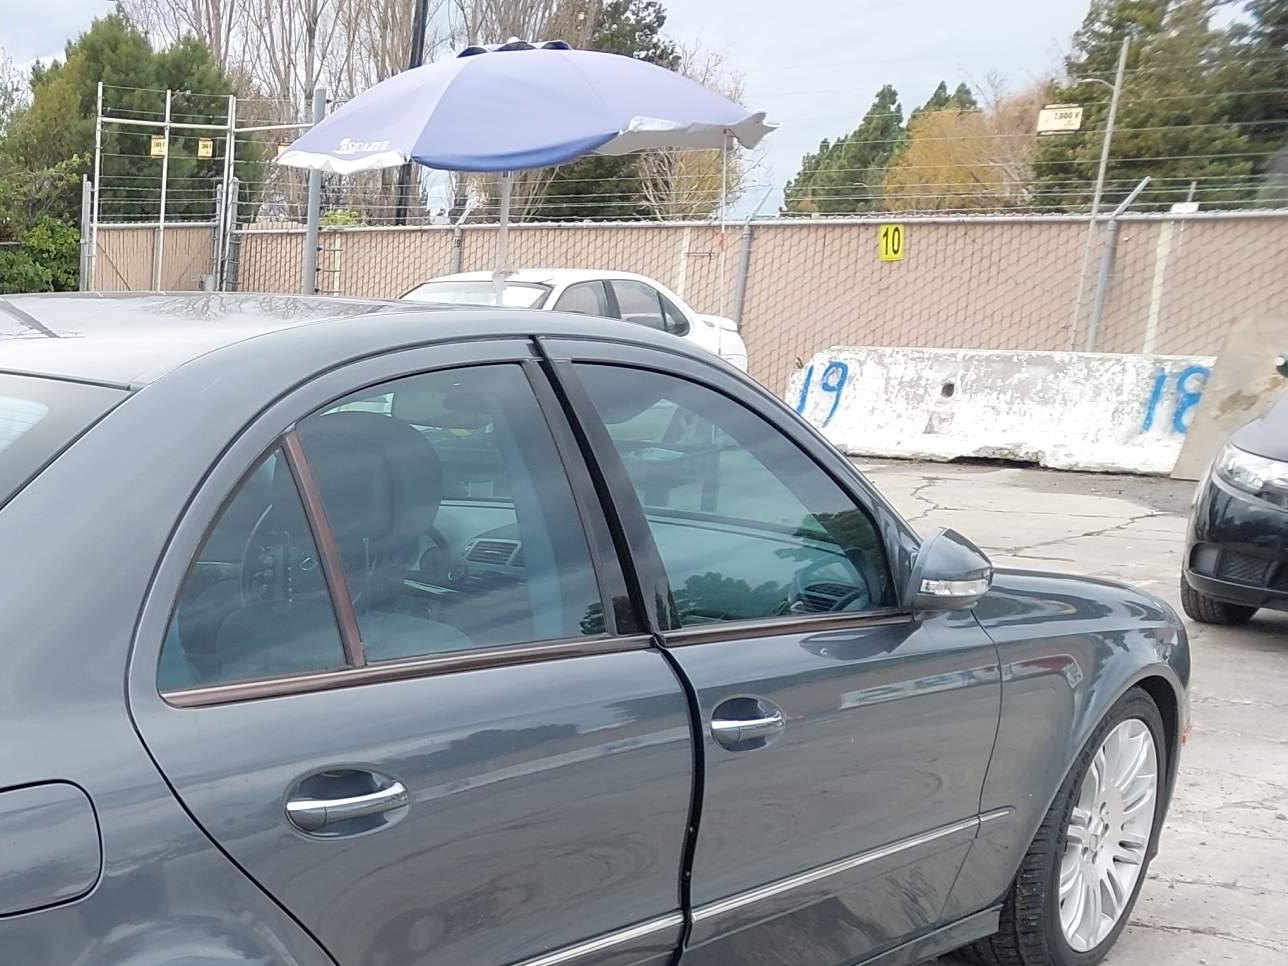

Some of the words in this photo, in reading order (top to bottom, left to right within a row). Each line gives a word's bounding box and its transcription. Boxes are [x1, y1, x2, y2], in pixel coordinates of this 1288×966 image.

[882, 226, 901, 256] 10
[797, 361, 849, 428] 19
[1143, 366, 1210, 433] 18
